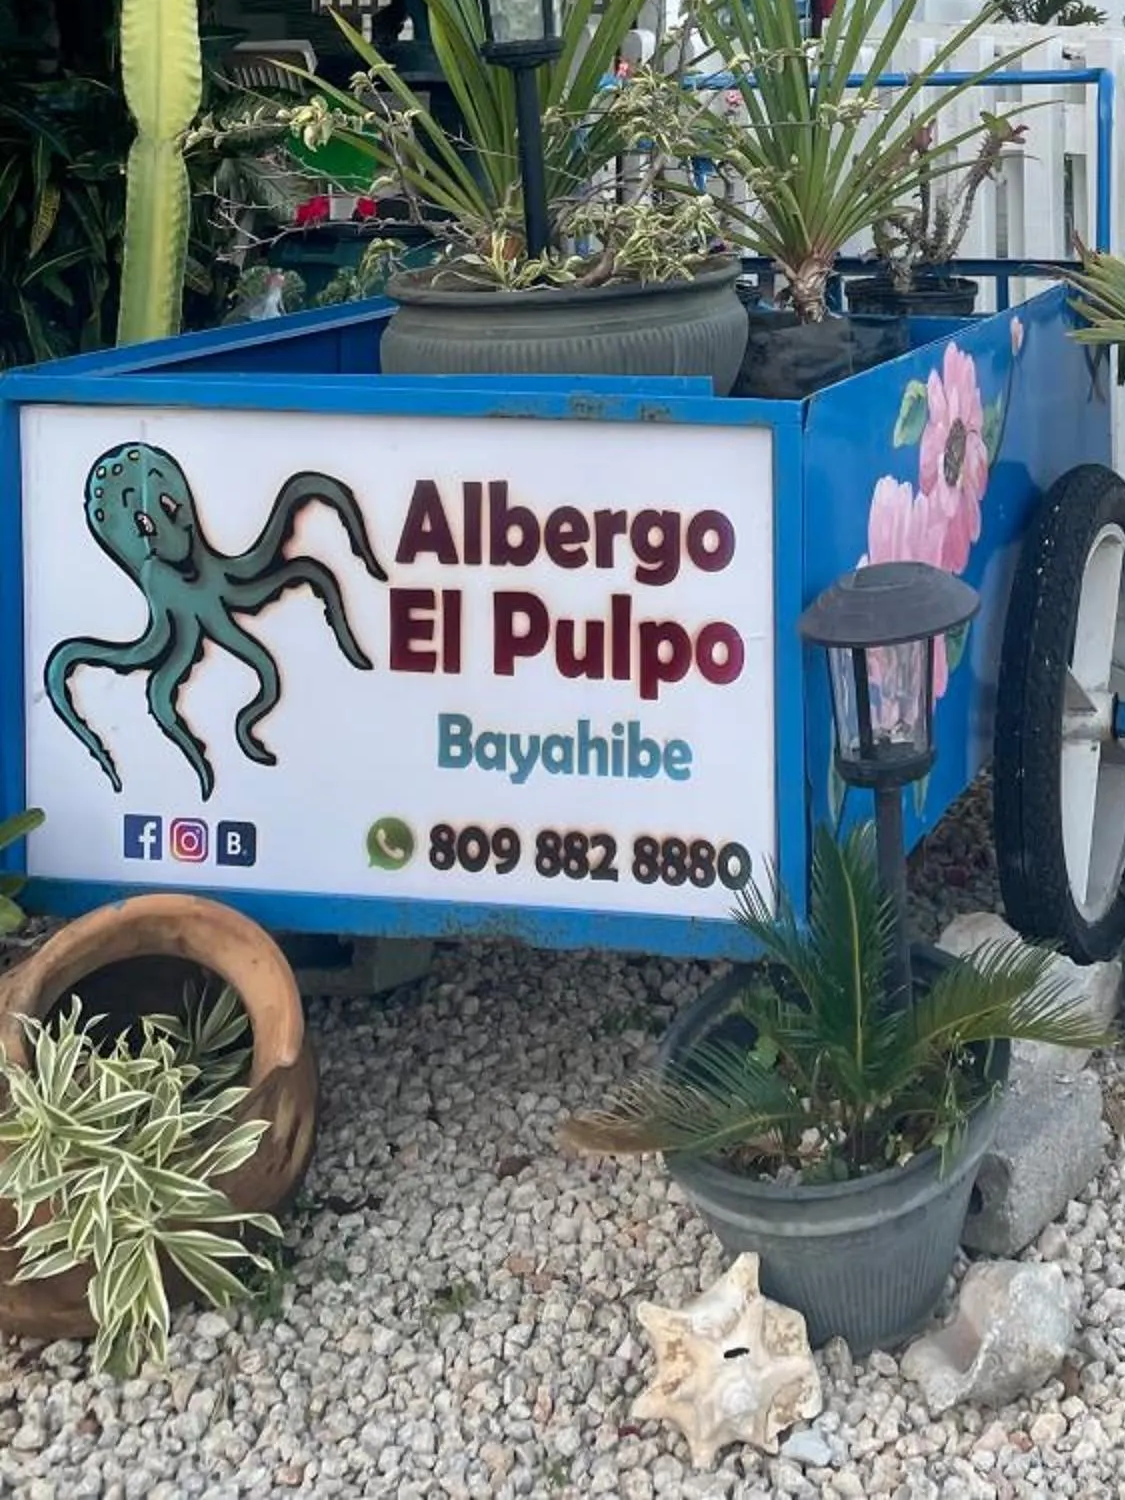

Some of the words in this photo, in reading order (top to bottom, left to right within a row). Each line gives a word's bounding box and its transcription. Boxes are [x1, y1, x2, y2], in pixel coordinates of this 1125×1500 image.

[395, 480, 736, 587] Albergo
[389, 588, 462, 675] El
[492, 591, 745, 701] Pulpo
[437, 713, 693, 785] Bayahibe
[429, 823, 521, 875] 809
[535, 830, 618, 882] 882
[632, 835, 752, 891] 8880
